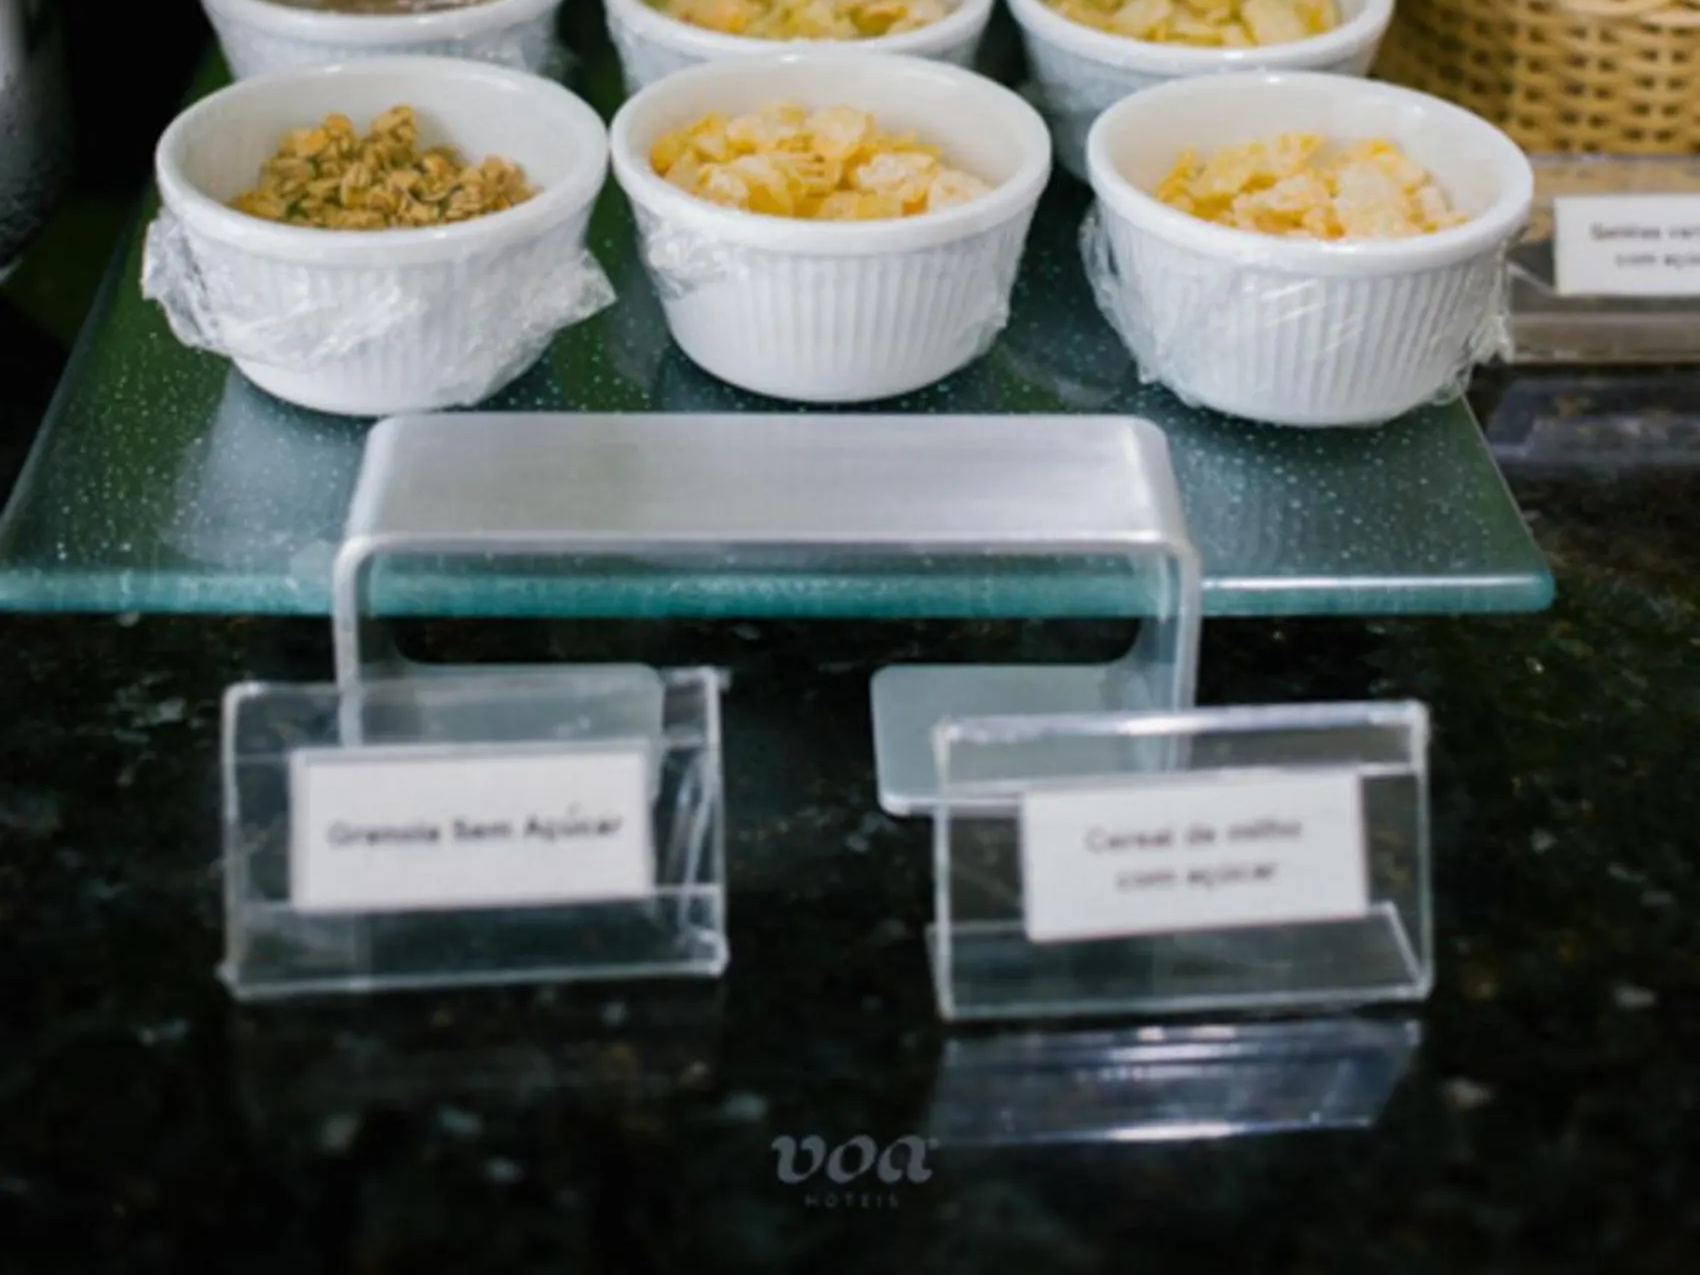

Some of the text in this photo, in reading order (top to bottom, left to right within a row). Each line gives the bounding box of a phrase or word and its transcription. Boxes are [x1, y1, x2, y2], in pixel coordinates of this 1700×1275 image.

[328, 800, 622, 845] Granola Sem Açúcar
[1085, 825, 1173, 852] Cereal
[1186, 823, 1217, 844] de
[1116, 871, 1177, 892] com
